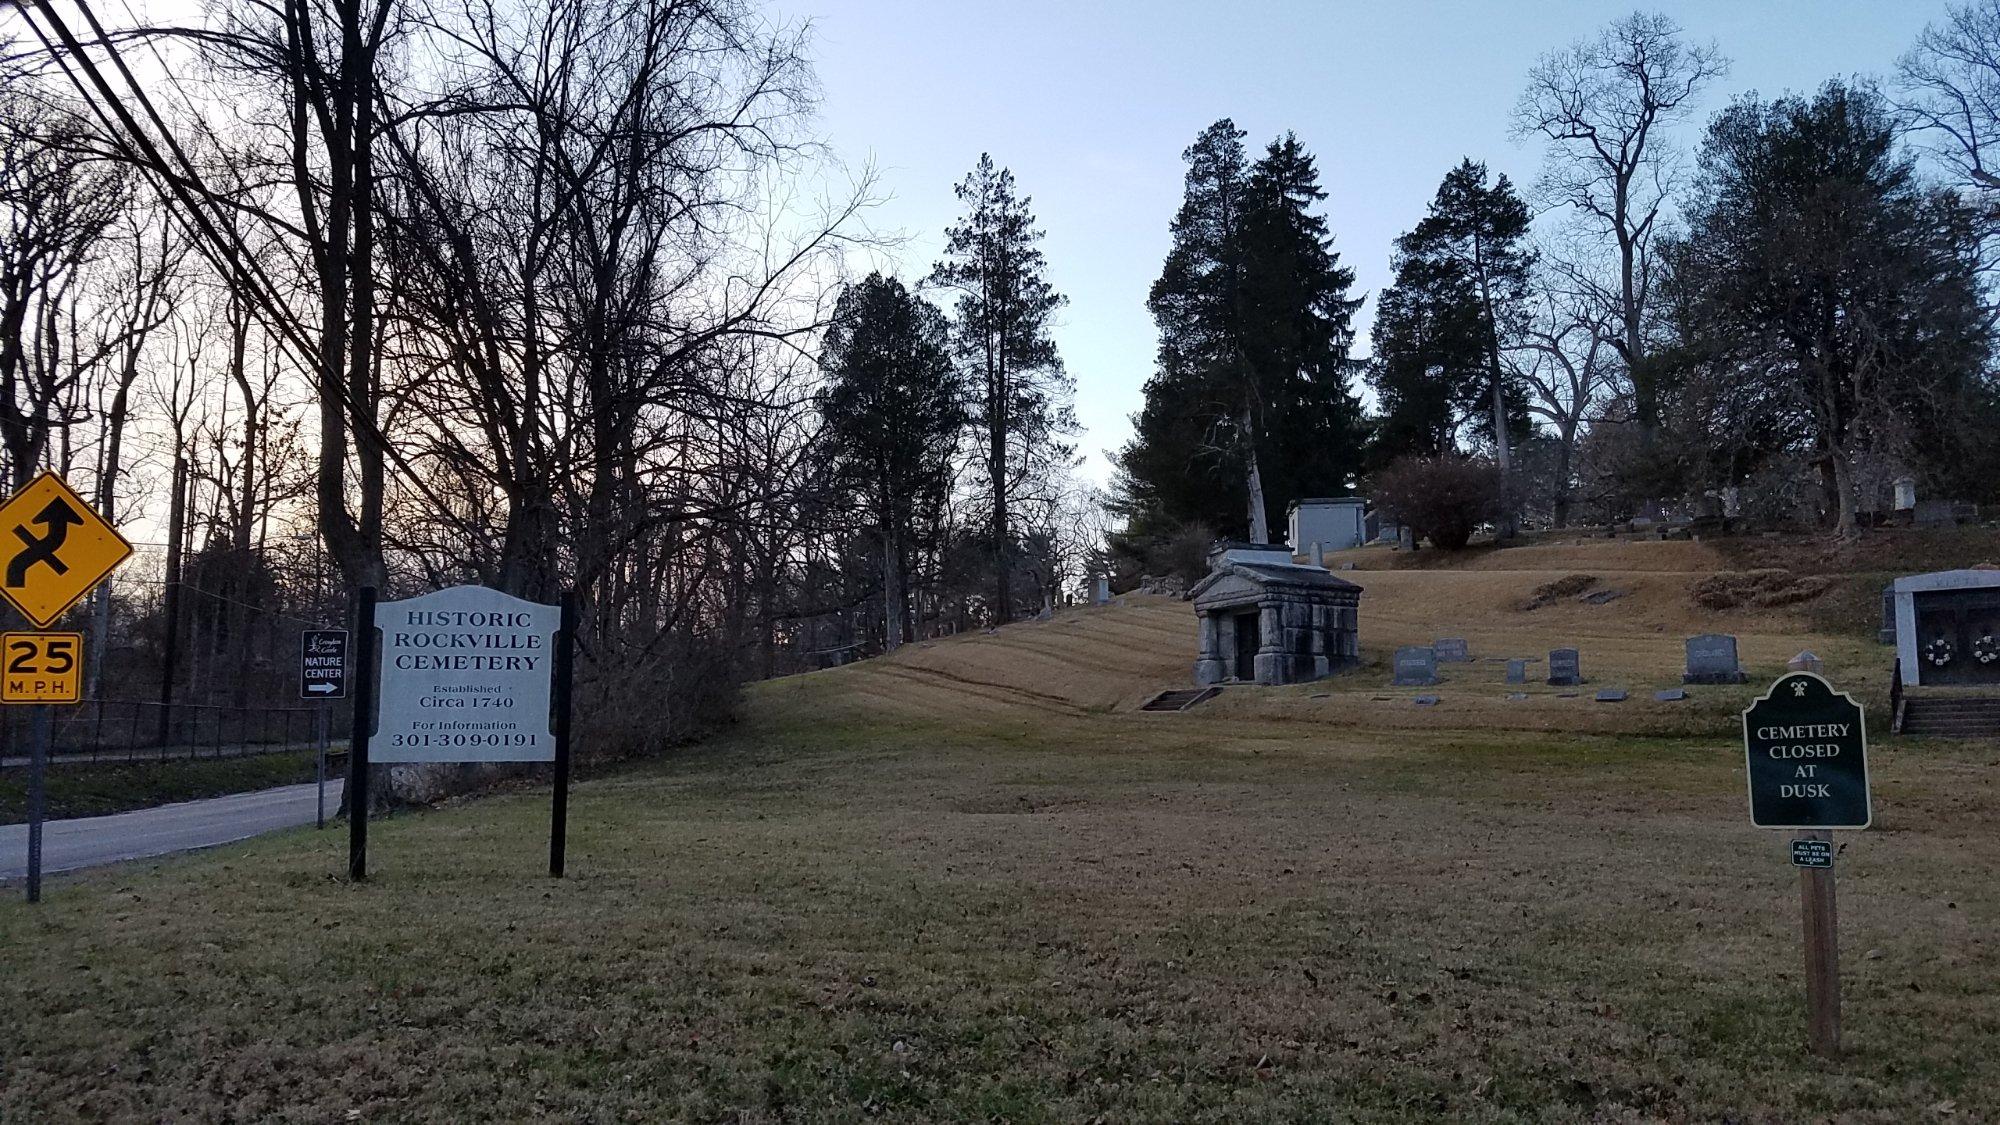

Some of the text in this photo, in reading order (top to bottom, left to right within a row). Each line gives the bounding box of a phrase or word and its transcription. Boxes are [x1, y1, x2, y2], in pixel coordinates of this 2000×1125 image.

[407, 611, 531, 628] HISTORIC
[394, 633, 541, 649] ROCKVILLE
[8, 641, 74, 675] 25
[305, 656, 342, 667] NATURE
[395, 655, 540, 671] CEMETERY
[305, 669, 342, 679] CENTER
[9, 680, 70, 694] M.P.H.
[433, 685, 501, 694] Established
[419, 696, 514, 709] Circa 1740
[412, 721, 517, 731] For Information
[1757, 723, 1850, 740] CEMETERY
[392, 734, 536, 747] 301-309-0191
[1769, 744, 1840, 759] CLOSED
[1794, 764, 1817, 778] AT
[1780, 784, 1831, 798] DUSK
